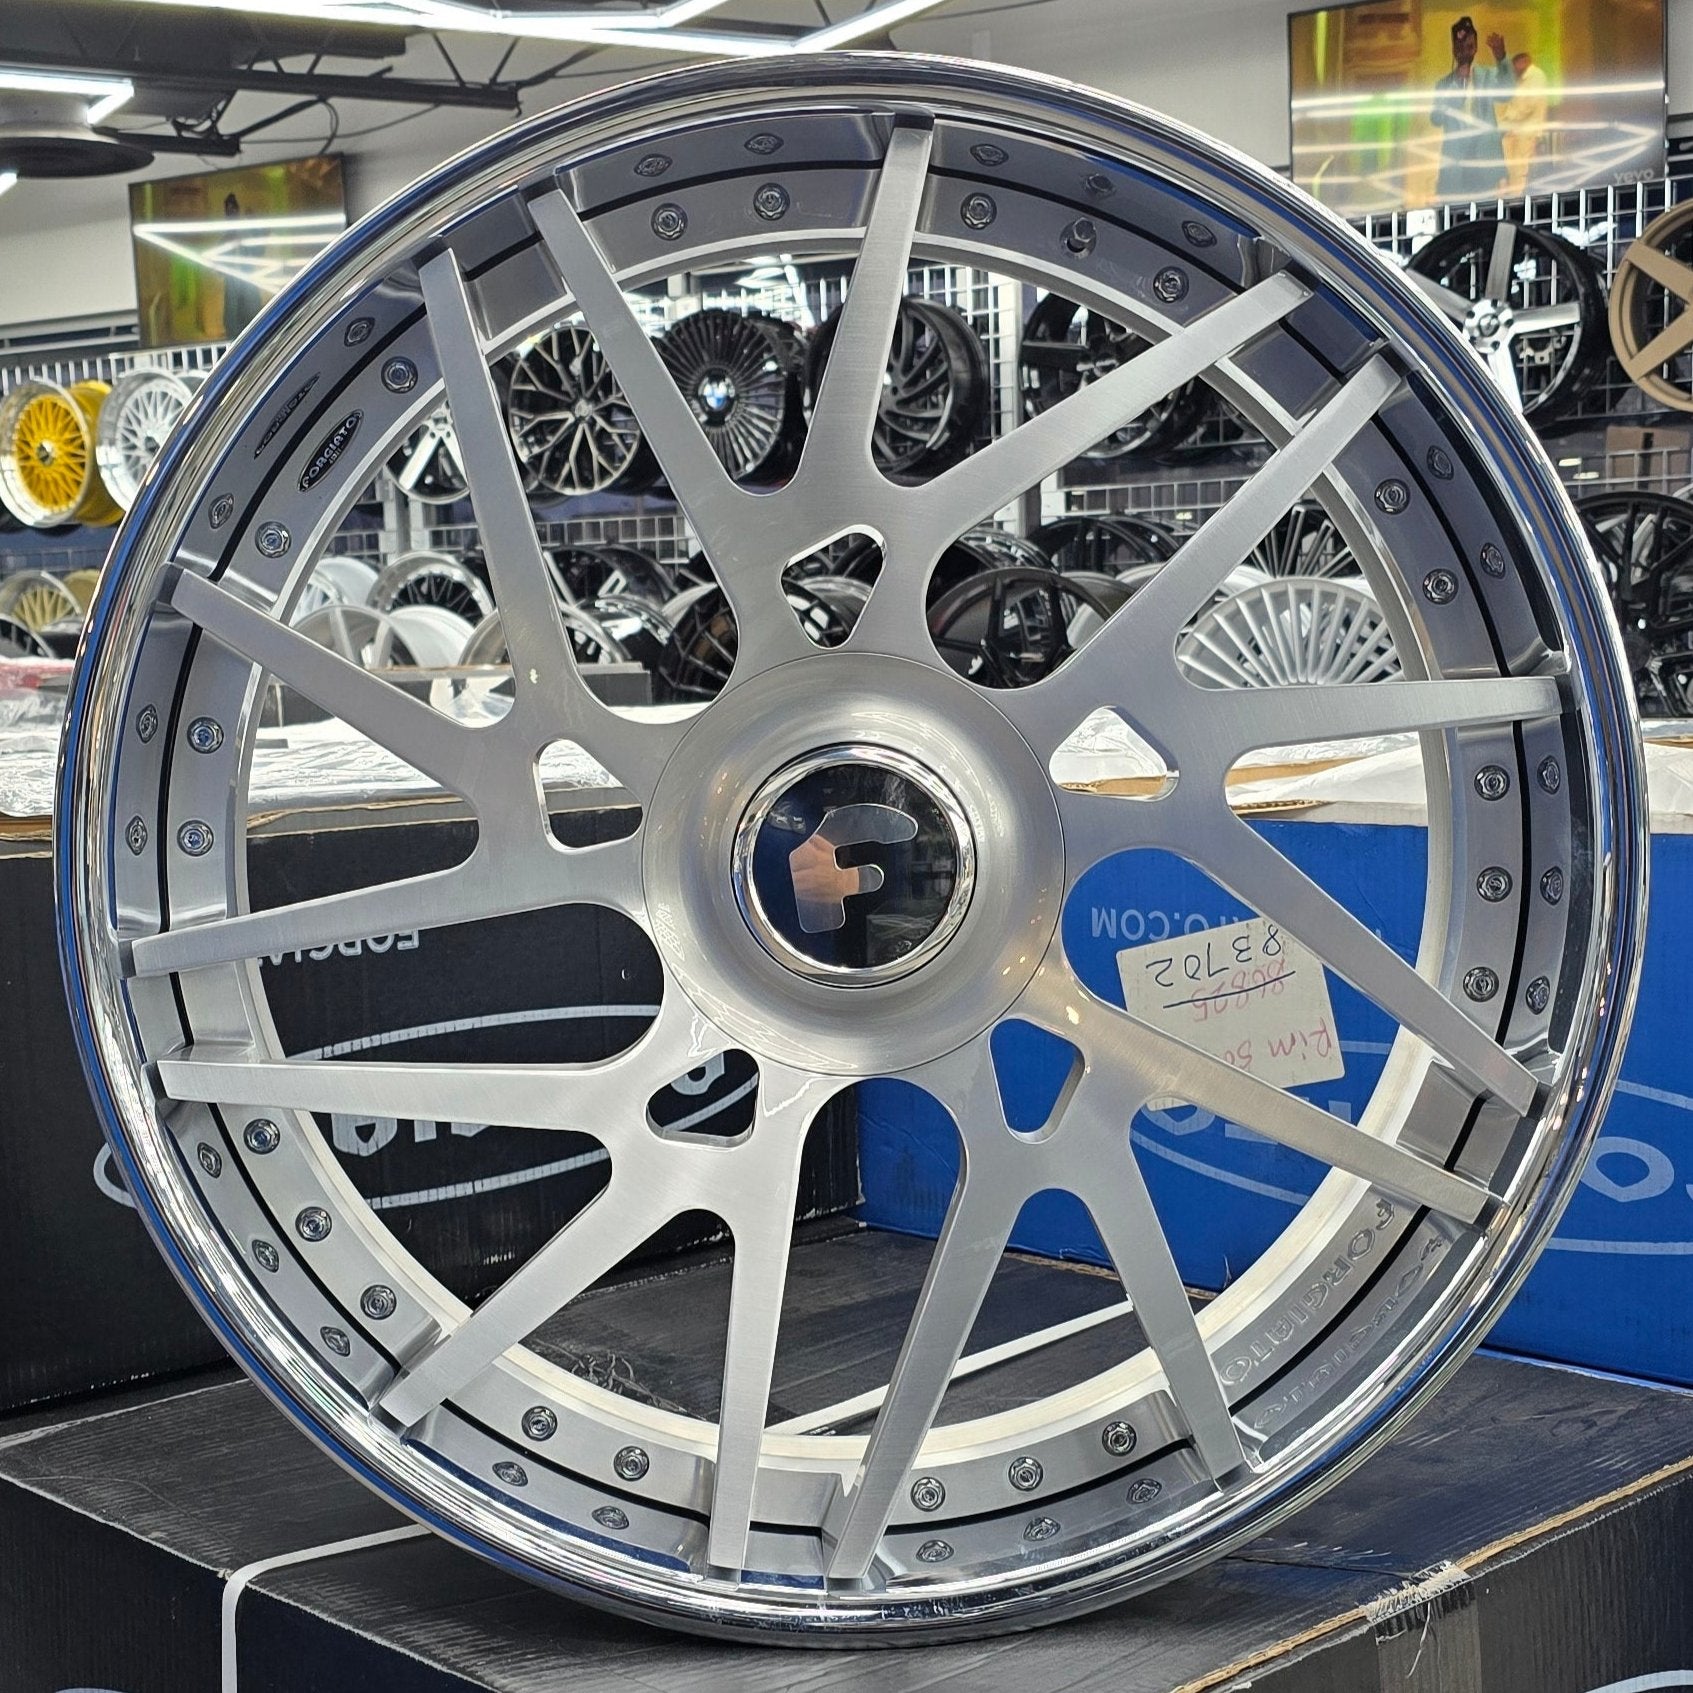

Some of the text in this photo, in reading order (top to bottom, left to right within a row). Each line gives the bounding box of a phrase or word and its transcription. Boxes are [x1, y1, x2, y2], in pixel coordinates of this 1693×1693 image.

[301, 416, 358, 489] FORGIATO
[1146, 923, 1282, 987] 83702
[1269, 1016, 1333, 1060] Rim
[1219, 1198, 1395, 1385] FORGIATO
